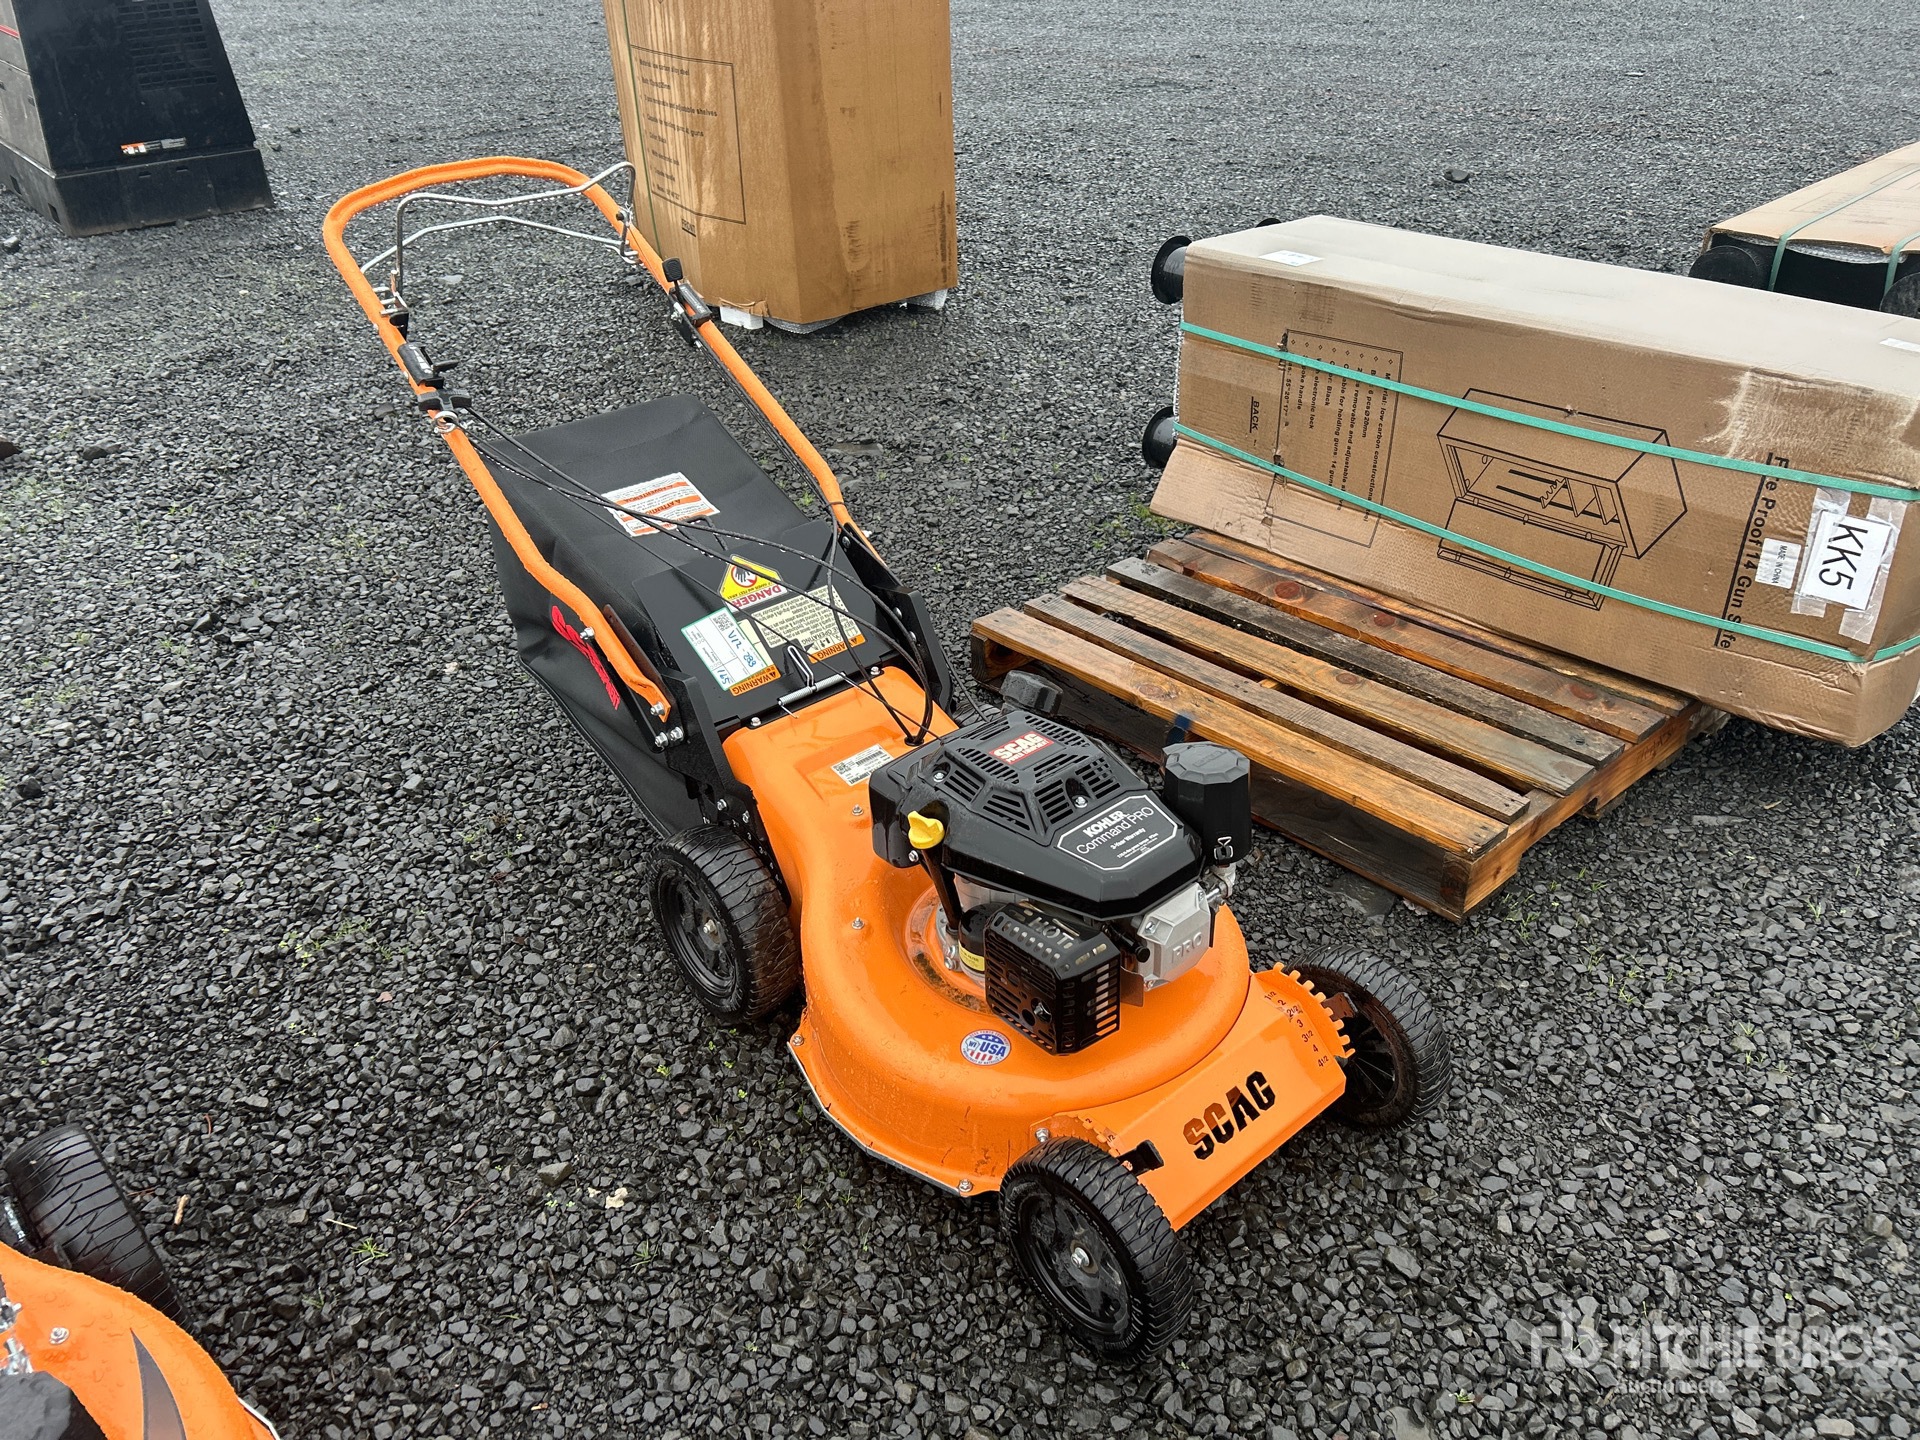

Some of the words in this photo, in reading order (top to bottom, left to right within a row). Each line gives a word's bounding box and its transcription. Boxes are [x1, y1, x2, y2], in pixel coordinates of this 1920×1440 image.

[697, 107, 718, 116] shelves
[1310, 376, 1318, 413] electronic
[1324, 386, 1332, 406] Black
[1338, 396, 1346, 407] for
[1252, 400, 1260, 431] BACK
[1350, 388, 1359, 428] removable
[1334, 408, 1343, 438] holding
[1374, 422, 1383, 449] carbon
[1346, 430, 1354, 444] and
[1331, 460, 1337, 470] 14
[1342, 444, 1351, 482] adjustable
[1367, 450, 1379, 500] constructiona
[1766, 456, 1790, 490] Fe
[1749, 497, 1776, 548] Proof
[1744, 552, 1760, 570] 14
[1776, 544, 1788, 560] MADE
[1818, 522, 1868, 590] KK5
[1772, 569, 1782, 584] CHINA
[732, 584, 781, 608] DANGER
[1732, 576, 1752, 609] Gun
[1720, 613, 1742, 648] Sfe
[817, 640, 848, 659] ARNING
[732, 674, 770, 694] WARNING
[994, 734, 1044, 758] SCAG
[1076, 820, 1132, 854] Command
[1127, 806, 1154, 824] PRO
[1124, 828, 1146, 842] Warranty
[1028, 916, 1074, 945] HOT
[1172, 932, 1202, 964] PRO
[1296, 1019, 1303, 1028] 3
[980, 1042, 1006, 1057] USA
[1312, 1044, 1318, 1052] 4
[1183, 1070, 1276, 1160] SCAG
